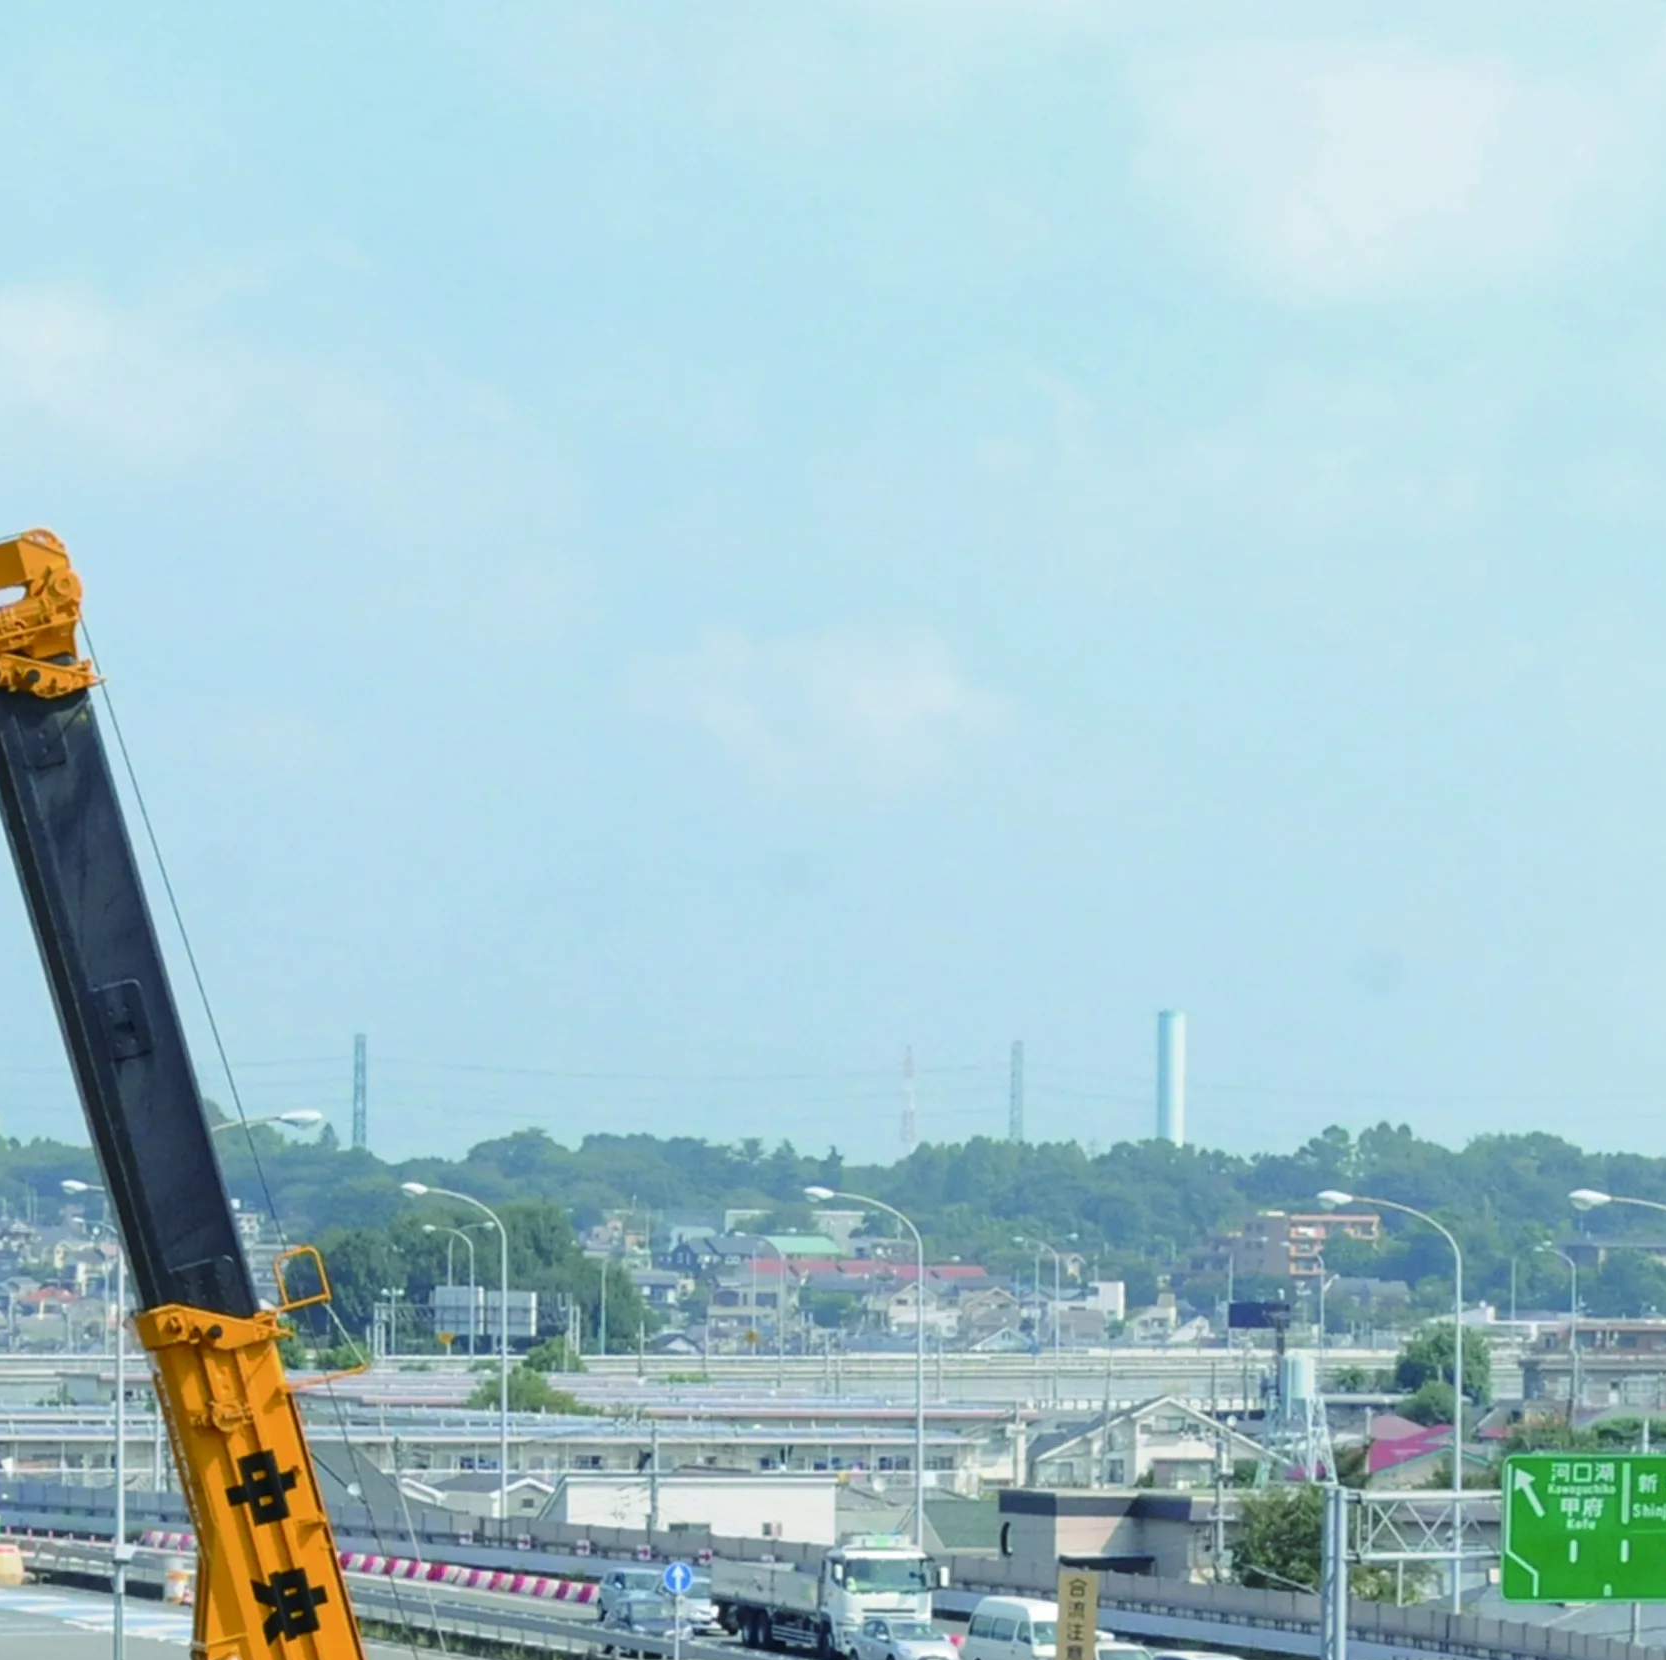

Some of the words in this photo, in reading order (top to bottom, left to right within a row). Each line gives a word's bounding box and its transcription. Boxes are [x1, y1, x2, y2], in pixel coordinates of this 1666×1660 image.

[1550, 1462, 1615, 1482] 河口湖
[1560, 1498, 1604, 1518] 甲府
